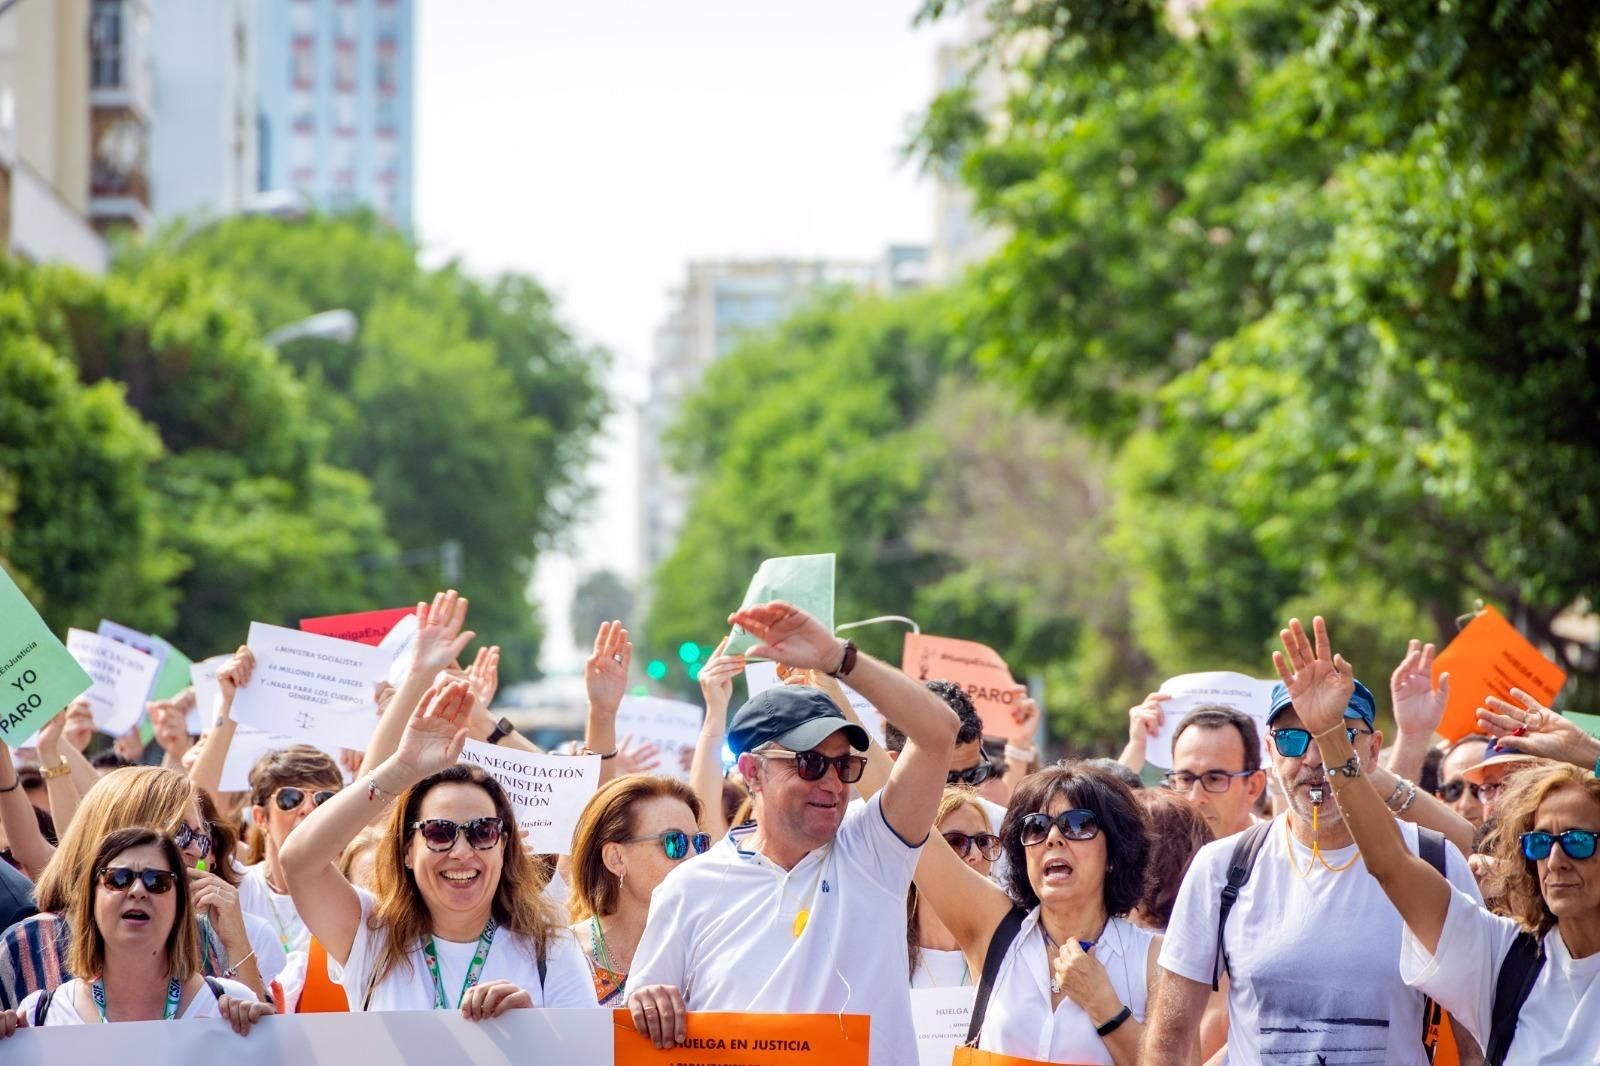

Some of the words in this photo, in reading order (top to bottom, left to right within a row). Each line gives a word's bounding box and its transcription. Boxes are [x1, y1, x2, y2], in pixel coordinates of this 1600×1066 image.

[0, 641, 38, 677] EnJusticia
[11, 669, 38, 692] YO
[316, 672, 337, 682] PARA
[967, 684, 1014, 705] PARO
[0, 693, 42, 735] PARO
[460, 750, 480, 763] SIN
[484, 756, 584, 779] NEGOCIACIÓN
[93, 984, 104, 1004] CSIF
[936, 1007, 969, 1016] HUELGA
[730, 1040, 748, 1050] EN
[752, 1040, 811, 1051] JUSTICIA
